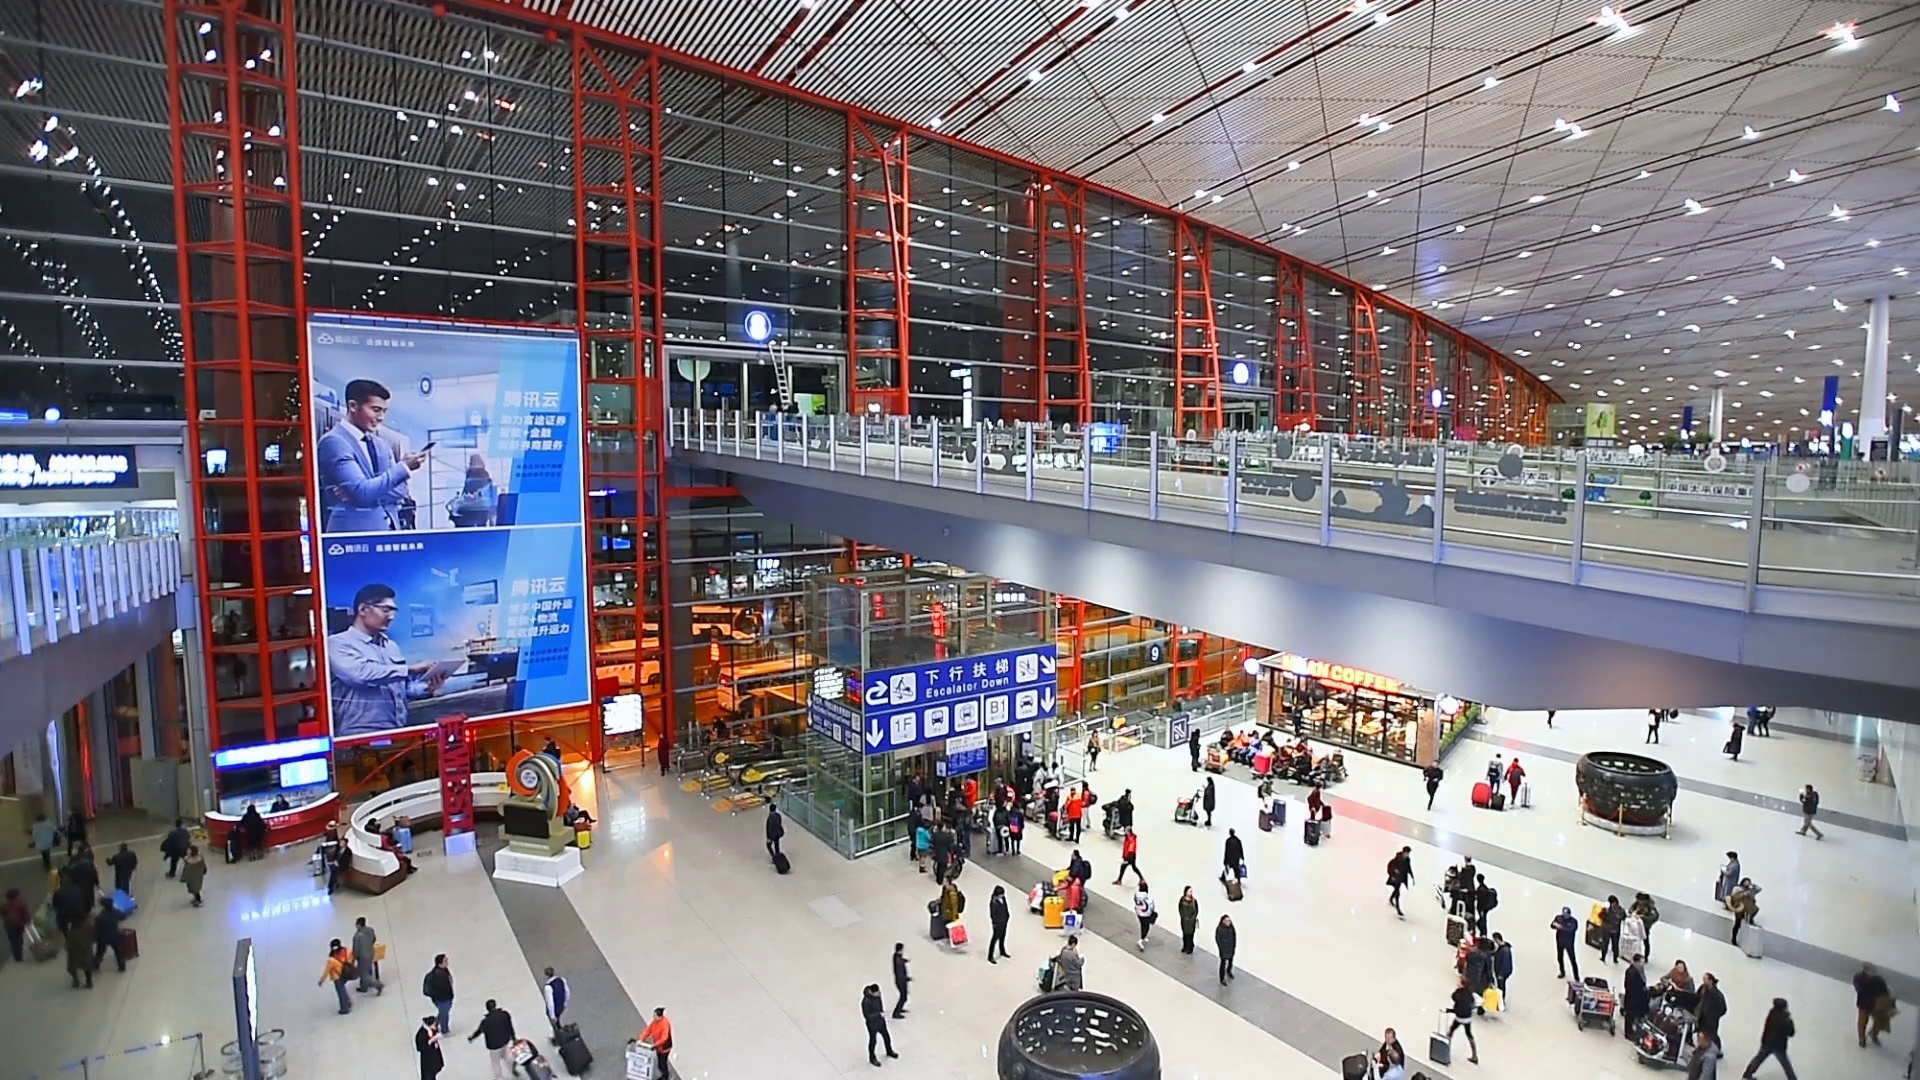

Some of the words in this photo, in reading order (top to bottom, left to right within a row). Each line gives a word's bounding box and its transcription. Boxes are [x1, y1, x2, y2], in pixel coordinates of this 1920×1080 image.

[1666, 482, 1754, 496] 中国太平保险集
[1151, 646, 1159, 661] 9
[924, 658, 1009, 686] 下行扶梯
[1331, 664, 1400, 694] COFFEE
[925, 681, 978, 699] Escalator
[981, 676, 1009, 689] Down
[990, 699, 1006, 714] B1
[895, 716, 912, 732] 1F
